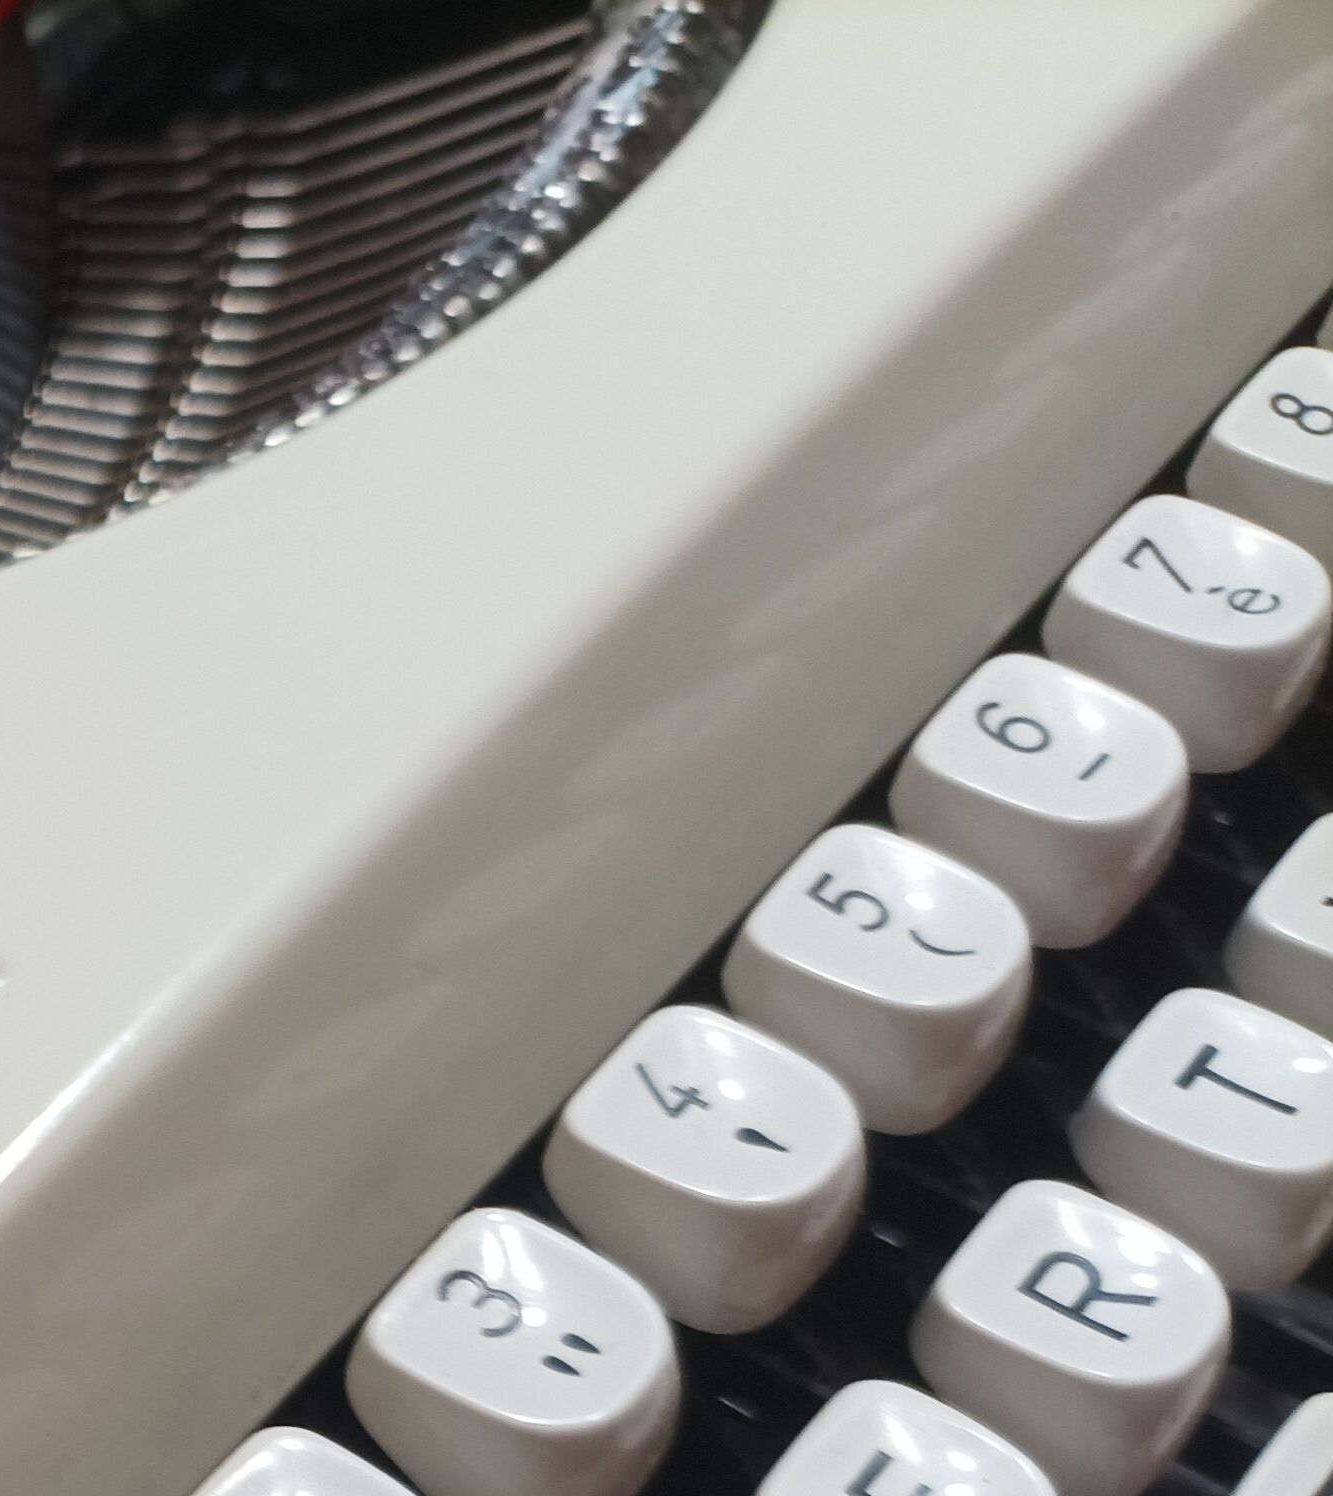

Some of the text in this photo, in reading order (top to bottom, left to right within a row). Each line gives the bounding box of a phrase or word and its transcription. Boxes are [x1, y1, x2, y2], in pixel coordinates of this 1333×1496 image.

[1270, 392, 1333, 435] 8
[1121, 537, 1193, 593] 7
[1207, 586, 1282, 614] è
[976, 702, 1052, 753] 6
[806, 872, 890, 932] 5
[636, 1062, 710, 1119] 4
[1175, 1043, 1299, 1117] T
[437, 1269, 522, 1338] 3
[1018, 1250, 1159, 1342] R
